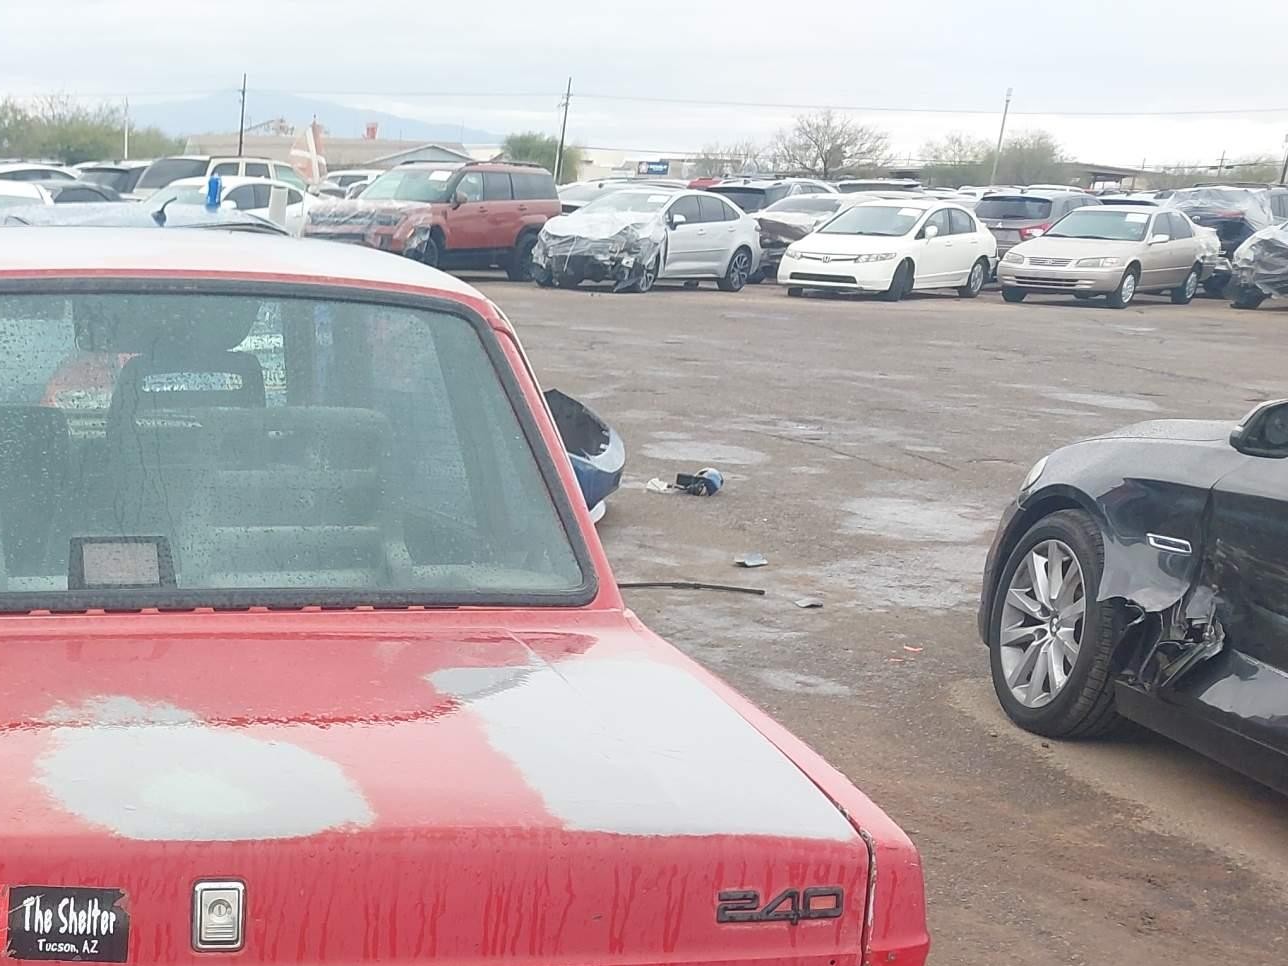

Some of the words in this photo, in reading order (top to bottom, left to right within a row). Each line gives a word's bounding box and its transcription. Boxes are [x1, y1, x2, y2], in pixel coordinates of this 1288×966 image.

[22, 896, 53, 935] The
[57, 897, 117, 937] Shelter
[717, 886, 844, 925] 240
[37, 939, 79, 954] Tucson,
[82, 940, 99, 954] AZ
